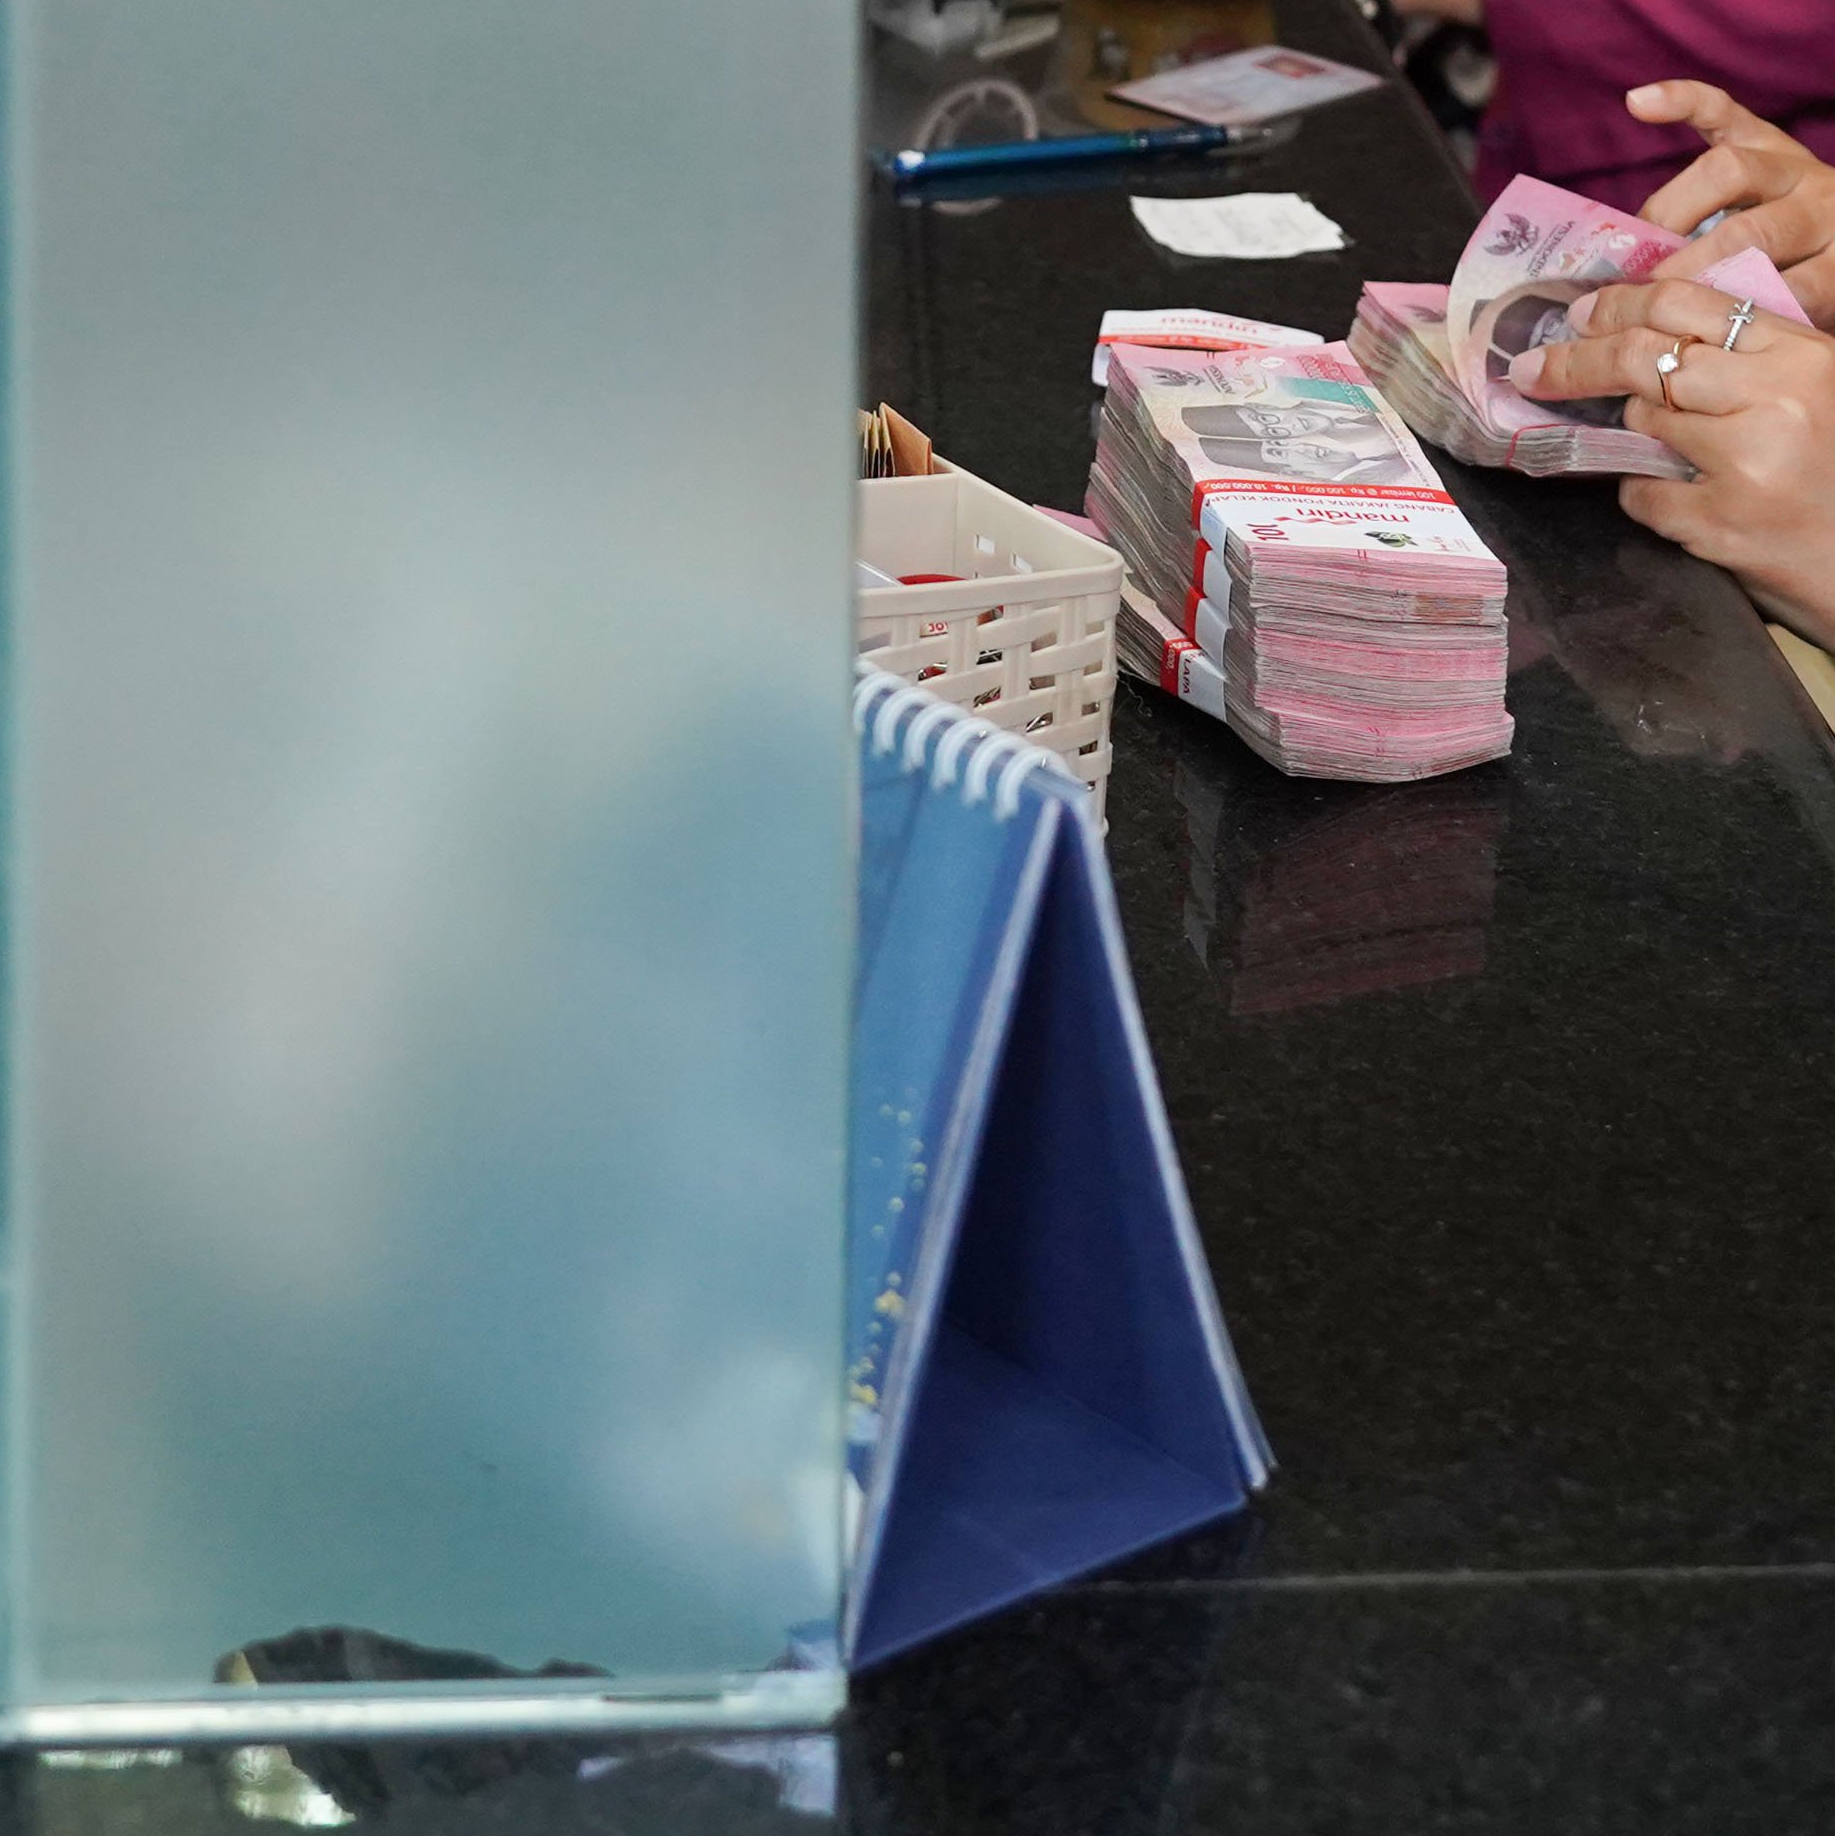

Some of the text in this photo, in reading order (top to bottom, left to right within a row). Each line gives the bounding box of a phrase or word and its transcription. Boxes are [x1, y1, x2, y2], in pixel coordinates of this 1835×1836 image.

[1259, 495, 1324, 505] PONDOK
[1327, 499, 1388, 509] JAKARTA
[1394, 504, 1455, 514] CABANG
[1296, 508, 1410, 523] mandiri
